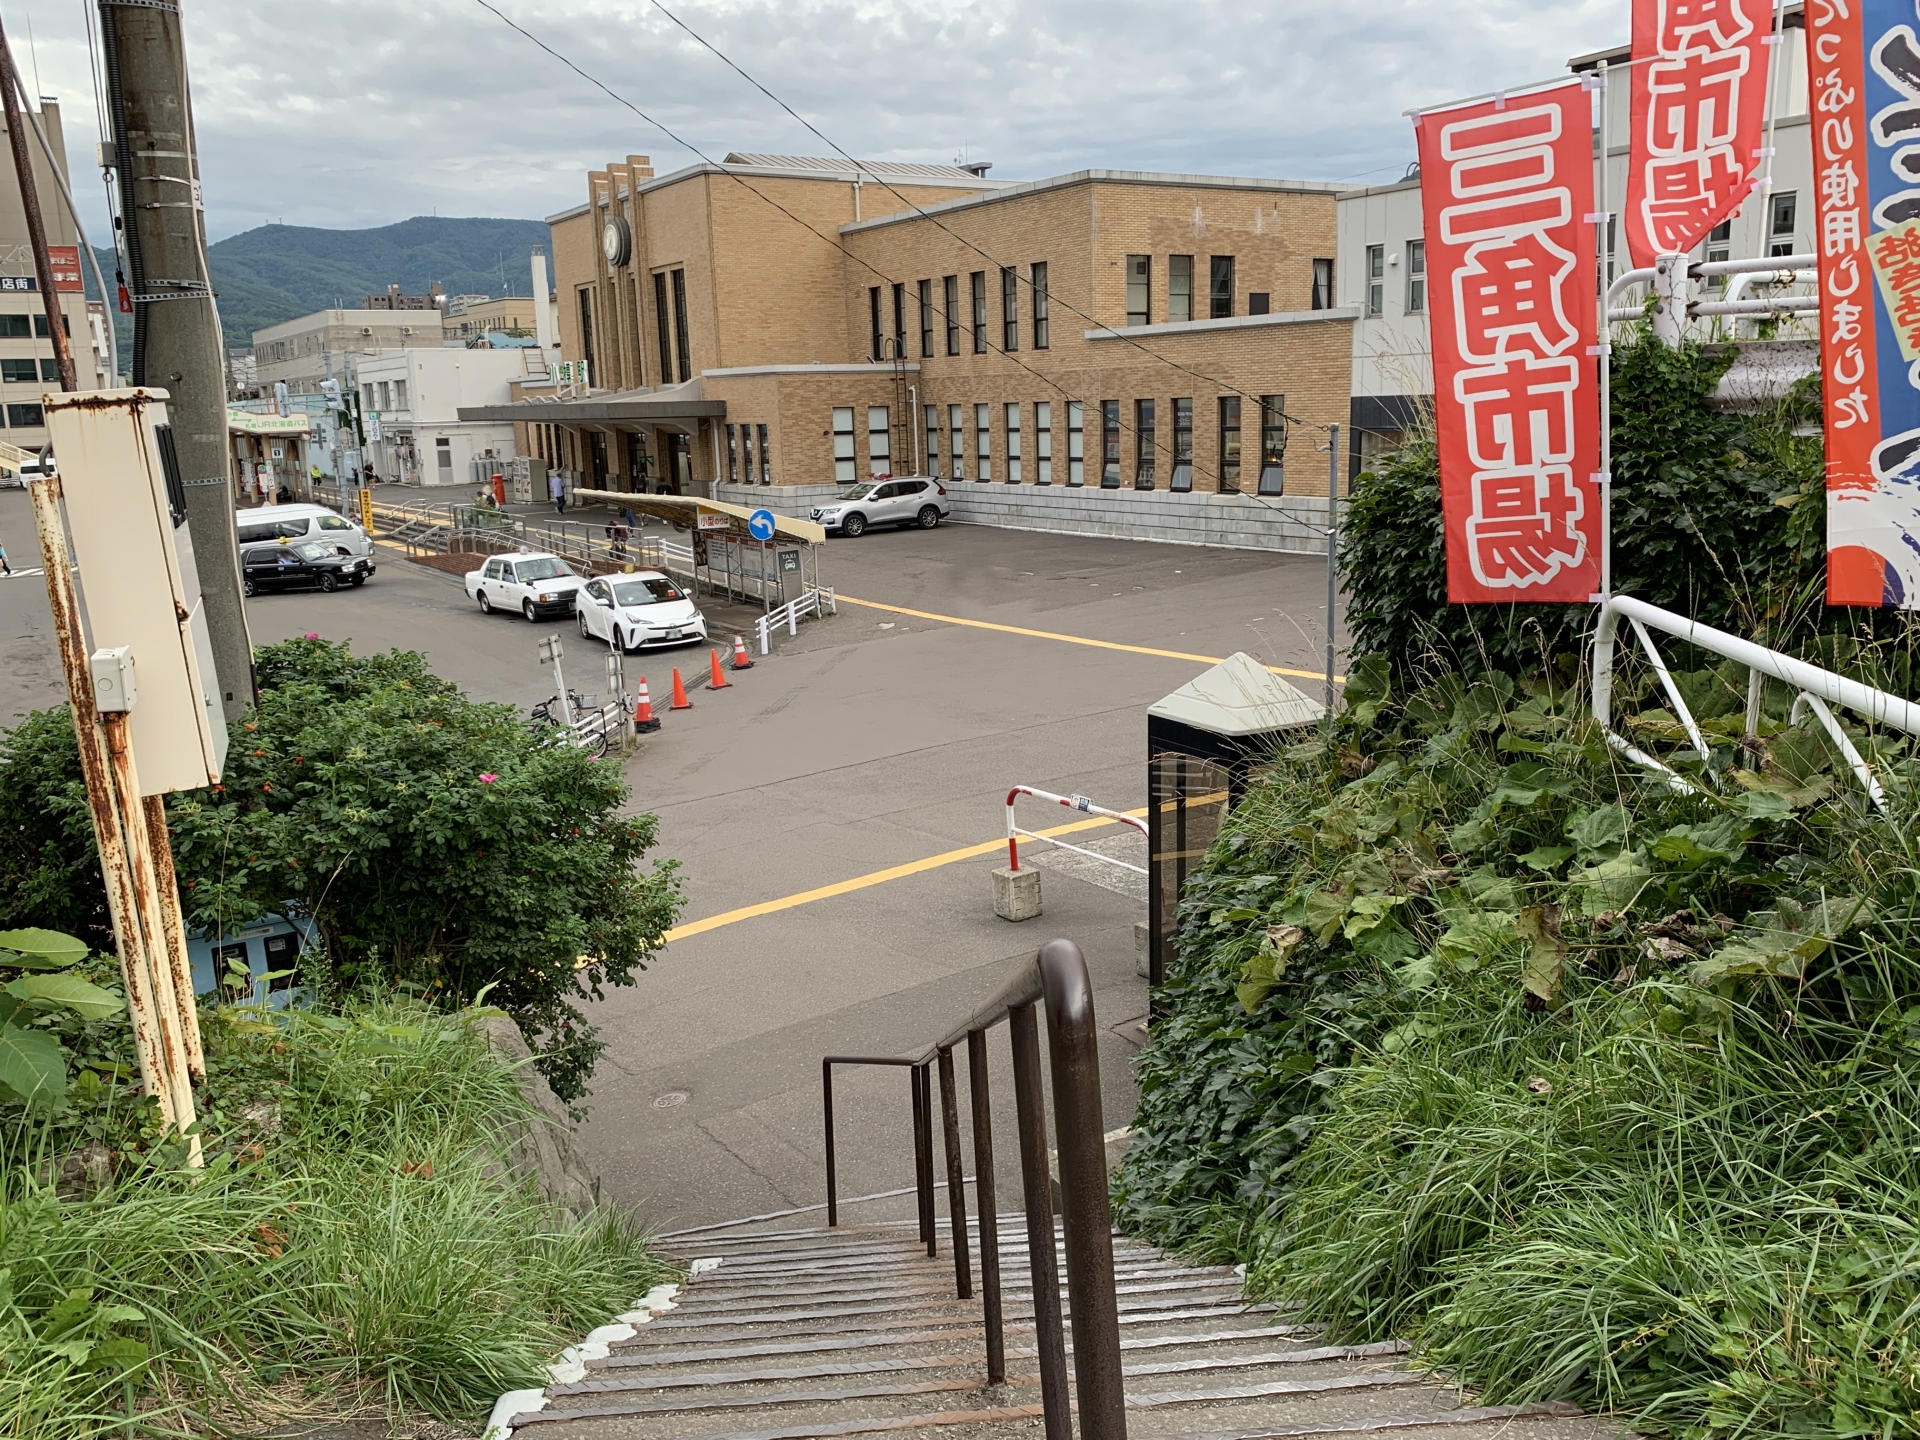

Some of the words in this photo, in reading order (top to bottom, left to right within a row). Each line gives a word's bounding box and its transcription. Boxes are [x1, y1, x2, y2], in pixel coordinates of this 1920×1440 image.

[0, 278, 28, 290] 店街
[258, 419, 308, 429] JR北海道バス
[700, 515, 729, 527] 小型のりば
[782, 552, 797, 560] TAXI
